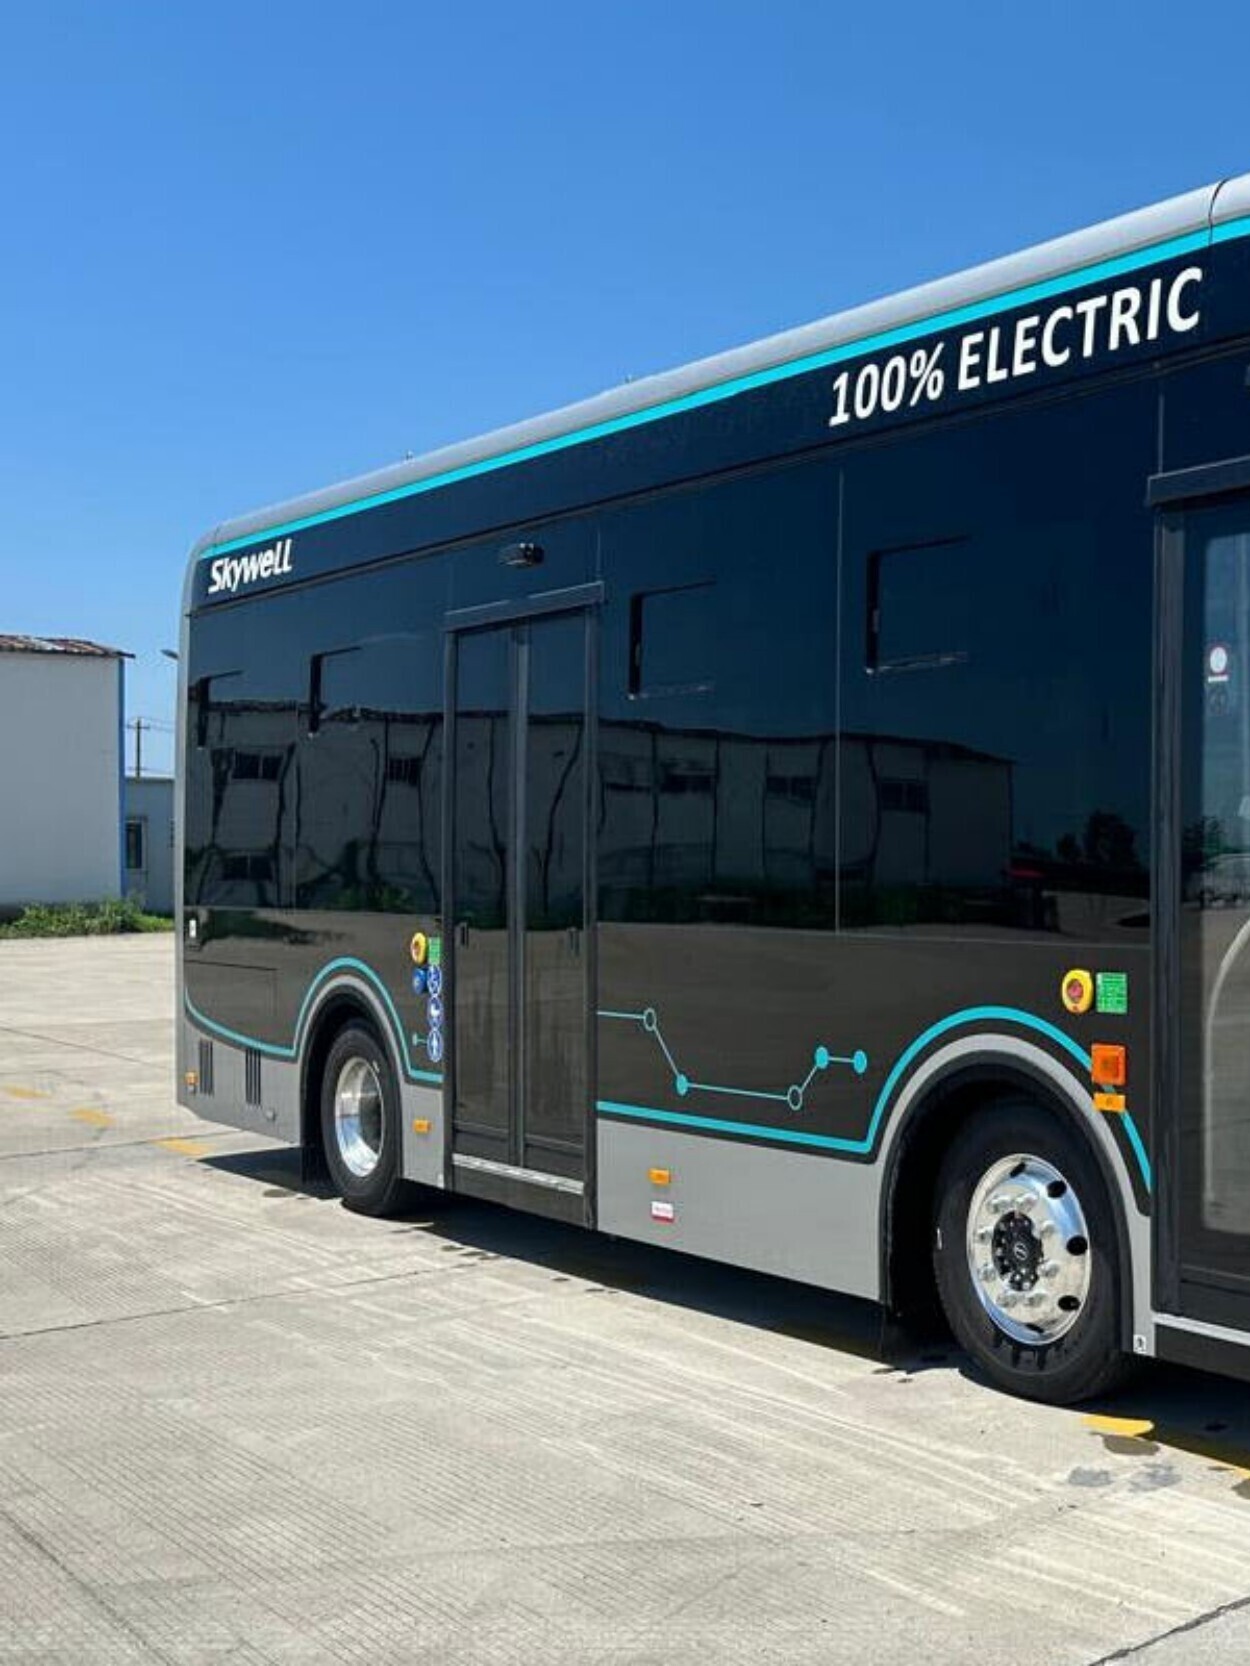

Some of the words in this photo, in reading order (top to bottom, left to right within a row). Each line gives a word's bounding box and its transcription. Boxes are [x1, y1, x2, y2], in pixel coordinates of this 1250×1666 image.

[829, 342, 944, 427] 100%
[957, 267, 1203, 391] ELECTRIC
[208, 538, 292, 594] Skywell
